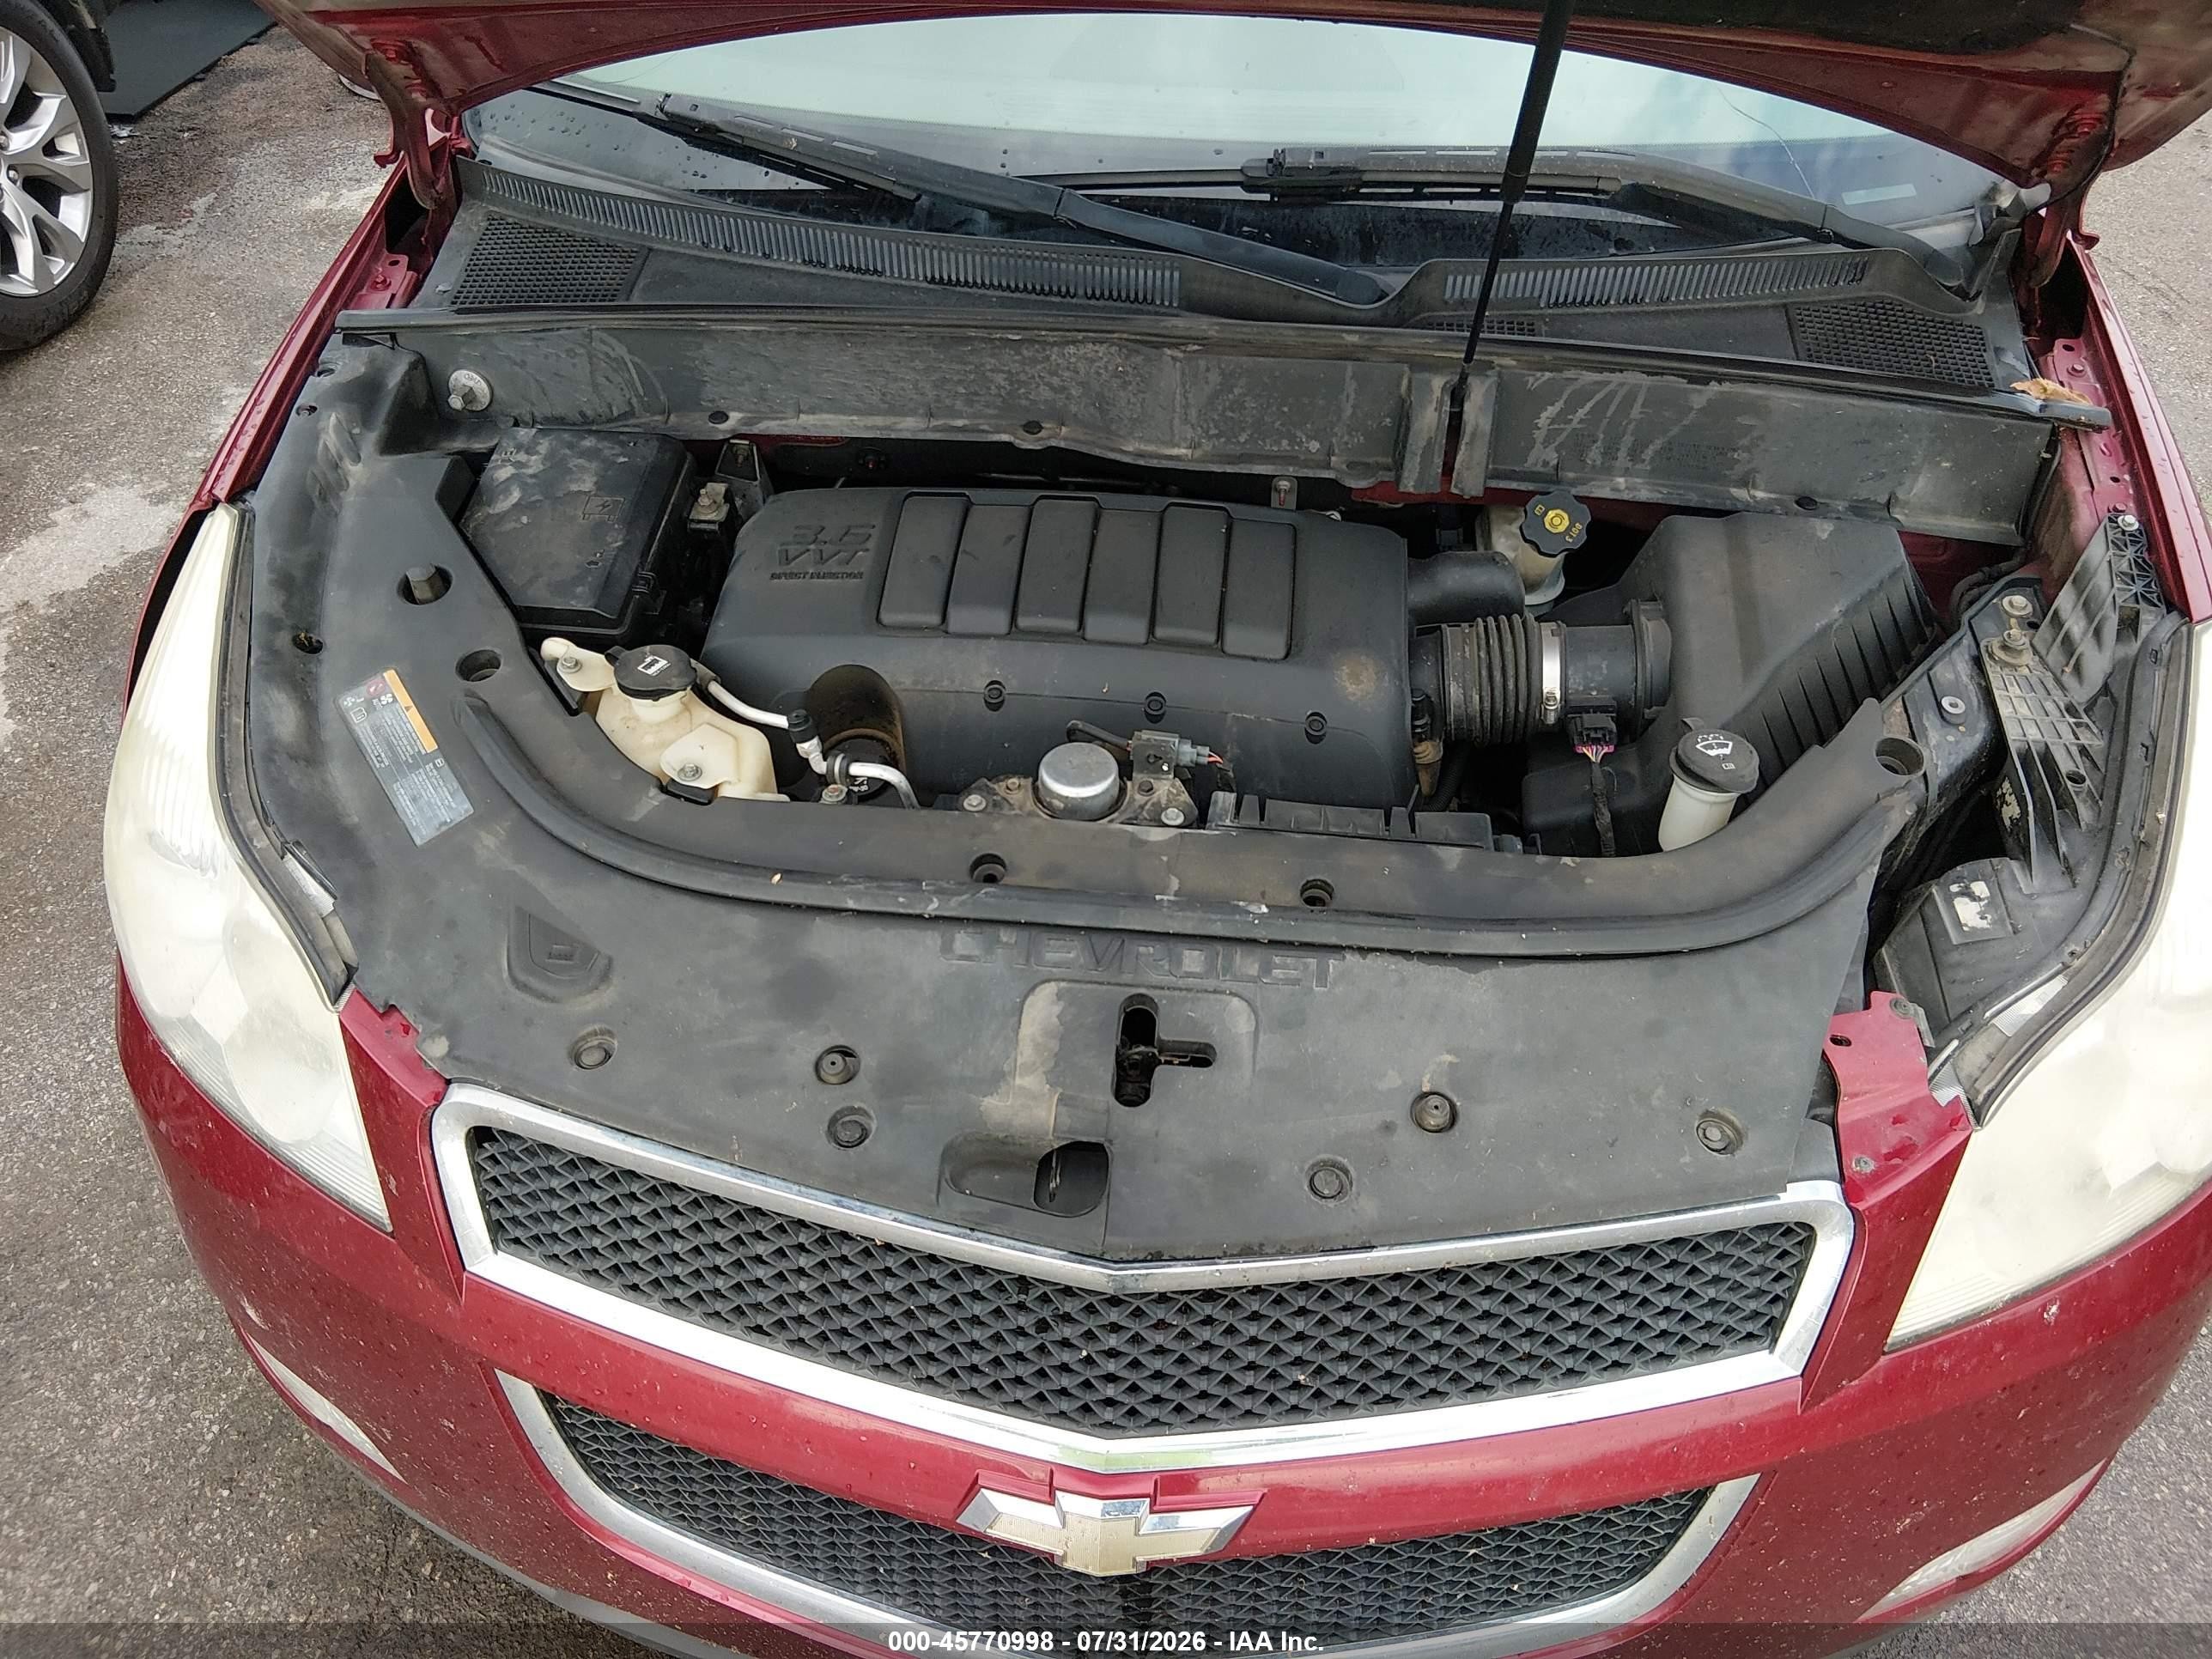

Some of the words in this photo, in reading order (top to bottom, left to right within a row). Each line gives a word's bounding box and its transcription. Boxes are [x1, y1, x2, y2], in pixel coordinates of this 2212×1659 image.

[792, 524, 876, 546] 3.6
[1570, 523, 1583, 537] DOT
[778, 547, 870, 566] VVT
[769, 572, 809, 580] DIRECT
[810, 572, 864, 580] INJECTION
[940, 927, 1346, 989] CHEVROLET
